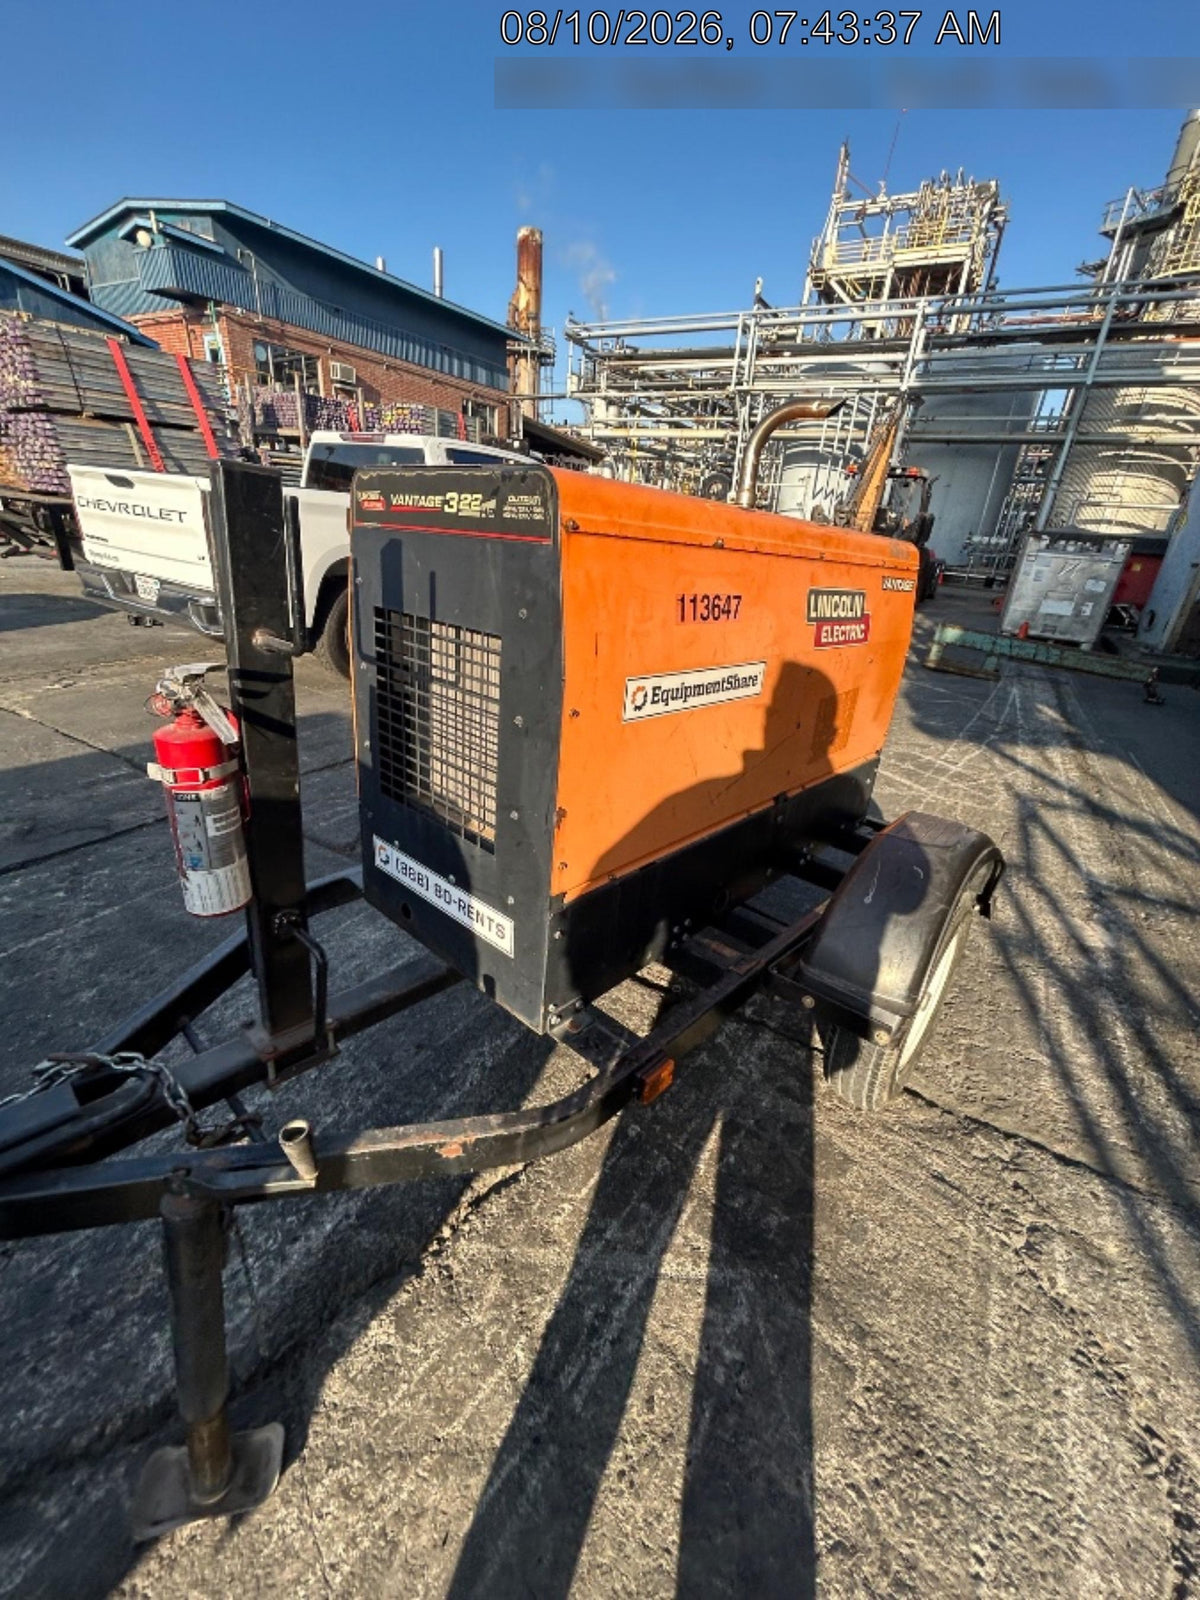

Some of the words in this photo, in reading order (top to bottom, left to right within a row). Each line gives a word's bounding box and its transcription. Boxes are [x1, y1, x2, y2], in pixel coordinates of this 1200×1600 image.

[77, 496, 187, 523] CHEVROLET
[390, 494, 442, 507] VANTAGE
[444, 492, 483, 512] 322
[677, 593, 742, 622] 113647
[810, 593, 863, 618] LINCOLN
[821, 623, 865, 643] ELECTRIC
[650, 673, 758, 706] EquipmentShare
